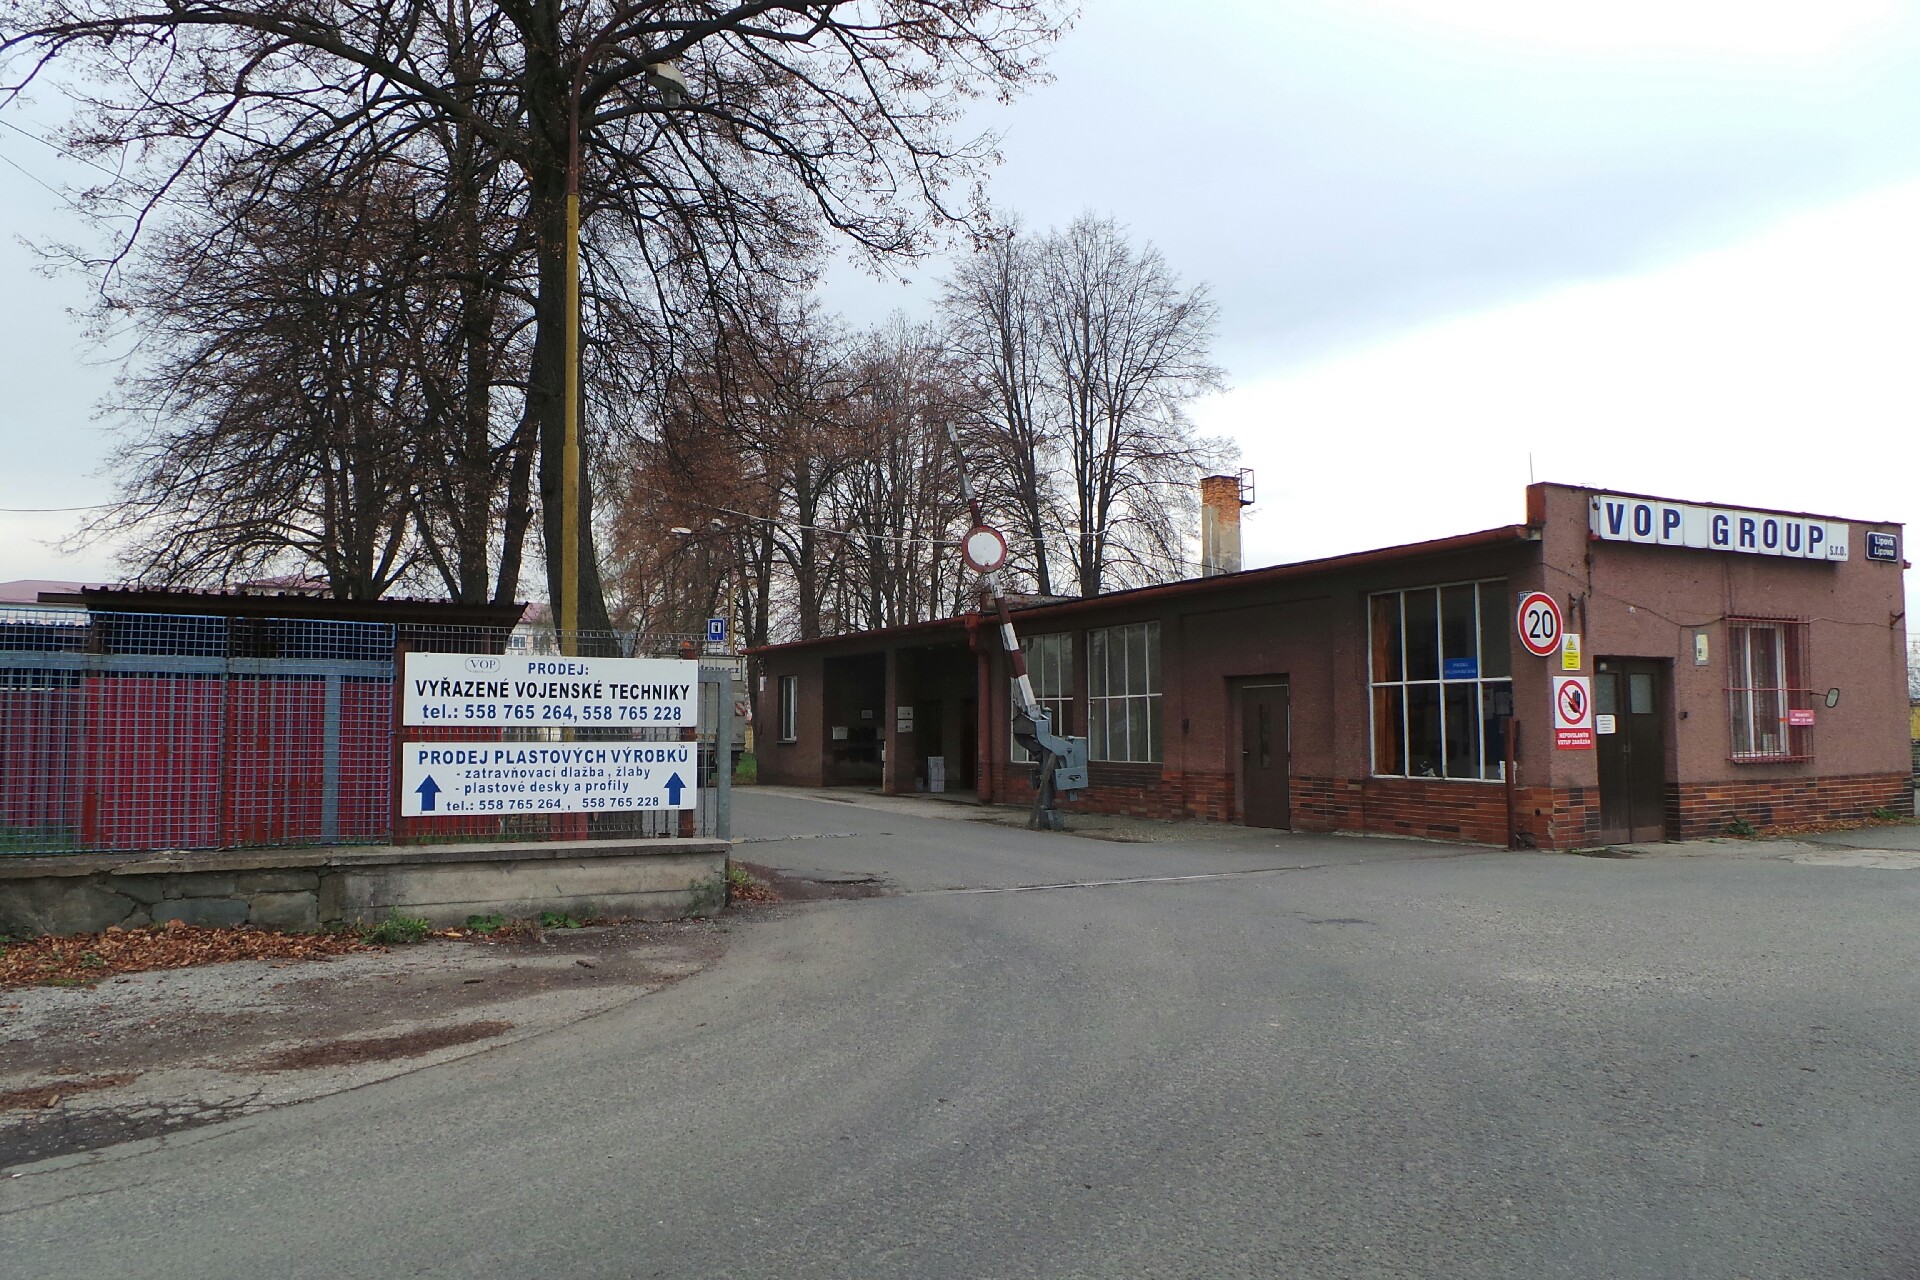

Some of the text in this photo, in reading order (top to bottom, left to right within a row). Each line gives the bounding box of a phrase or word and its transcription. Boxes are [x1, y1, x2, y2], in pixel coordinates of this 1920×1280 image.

[1605, 502, 1847, 557] VOP GROUP s.r.o.
[1528, 609, 1554, 639] 20
[470, 659, 496, 669] VOP
[528, 662, 589, 675] PRODEJ:
[415, 677, 690, 700] VYŘAZENÉ VOJENSKÉ TECHNIKY
[422, 704, 682, 723] tel.: 558 765 264, 558 765 228
[418, 744, 688, 765] PRODEJ PLASTOVÝCH VÝROBKŮ
[465, 766, 556, 779] zatravňovací
[616, 766, 650, 779] žlaby
[464, 781, 525, 796] plastové
[530, 780, 569, 795] desky
[574, 783, 581, 792] a
[585, 779, 629, 794] profily
[446, 801, 474, 812] tel.:
[479, 800, 504, 811] 558
[508, 799, 533, 810] 765
[582, 798, 605, 808] 558
[609, 797, 632, 807] 765
[637, 796, 659, 807] 228
